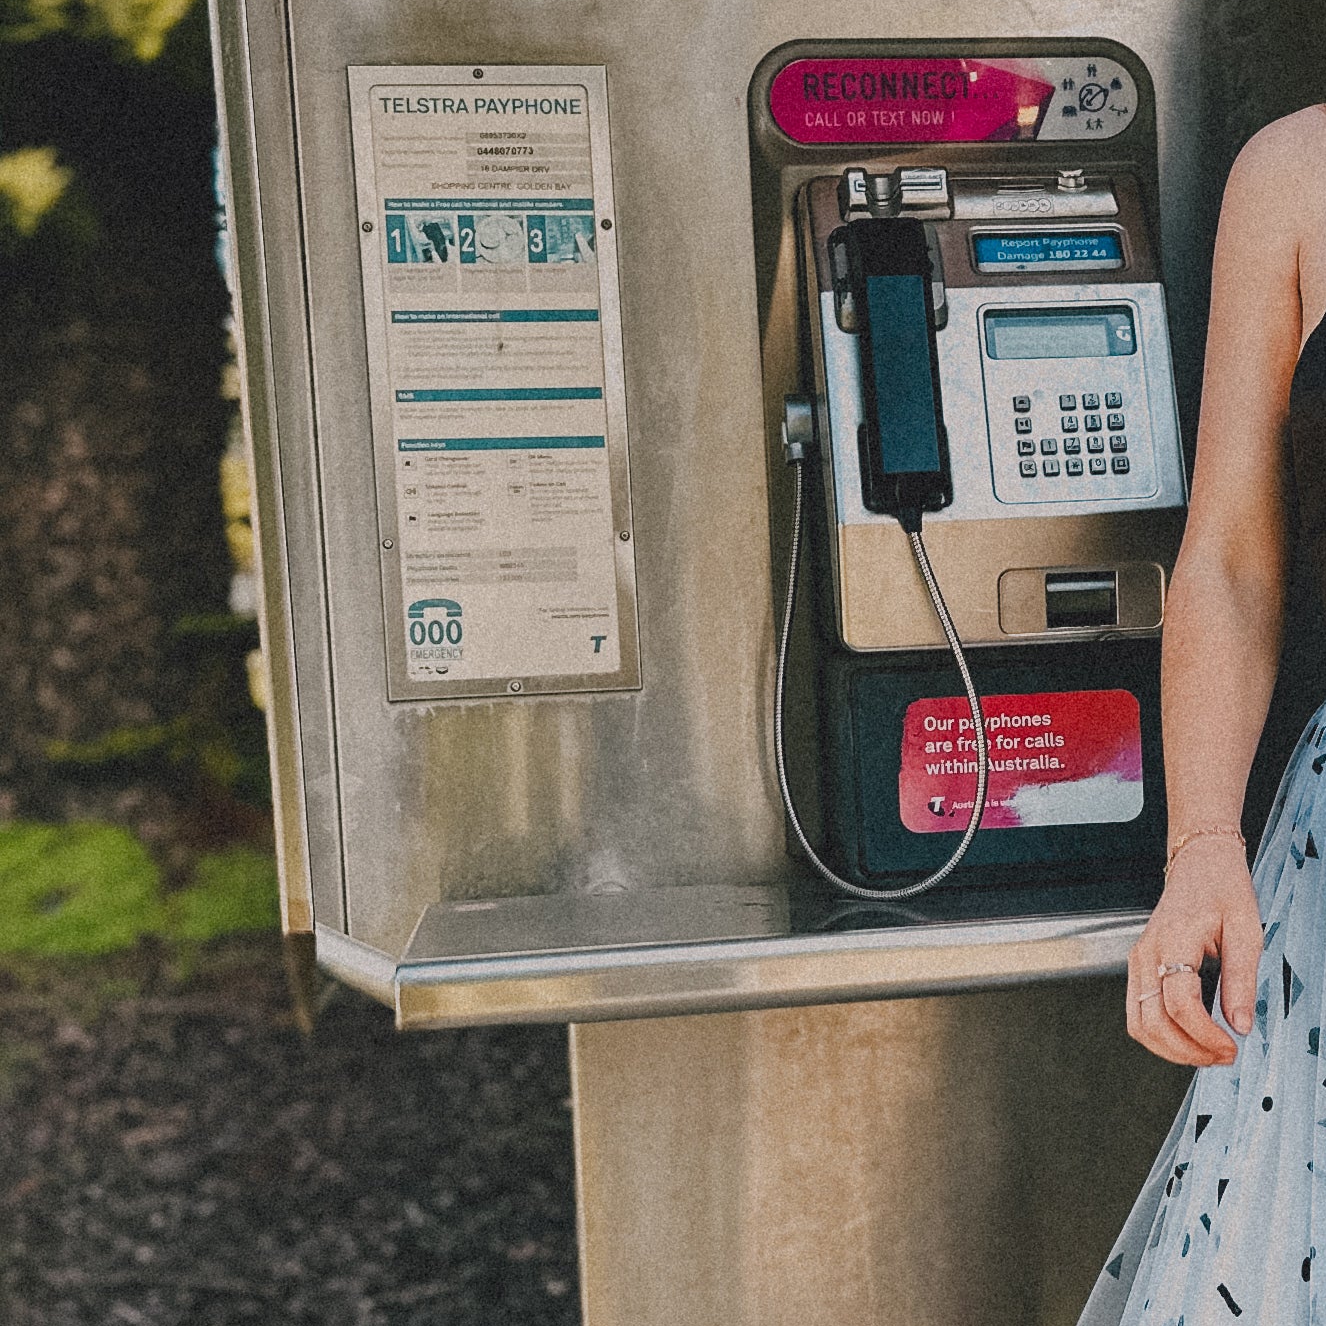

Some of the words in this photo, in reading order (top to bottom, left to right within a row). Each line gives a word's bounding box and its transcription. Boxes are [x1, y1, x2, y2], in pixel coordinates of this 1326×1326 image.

[379, 97, 469, 114] TELSTRA
[474, 98, 582, 115] PAYPHONE
[805, 112, 841, 127] CALL
[847, 111, 867, 126] OR
[872, 111, 906, 126] TEXT
[911, 110, 944, 125] NOW
[391, 228, 401, 253] 1
[460, 227, 475, 252] 2
[530, 228, 544, 253] 3
[1001, 239, 1040, 248] Report
[1043, 237, 1099, 248] Payphone
[997, 251, 1045, 262] Damage
[1074, 249, 1089, 258] 22
[1092, 249, 1107, 258] 44
[409, 619, 463, 646] 000
[591, 636, 607, 653] T
[410, 648, 464, 660] EMERGENCY
[924, 716, 954, 731] Our
[925, 740, 953, 754] are
[996, 734, 1021, 750] for
[1025, 732, 1065, 749] calls
[926, 758, 979, 775] within
